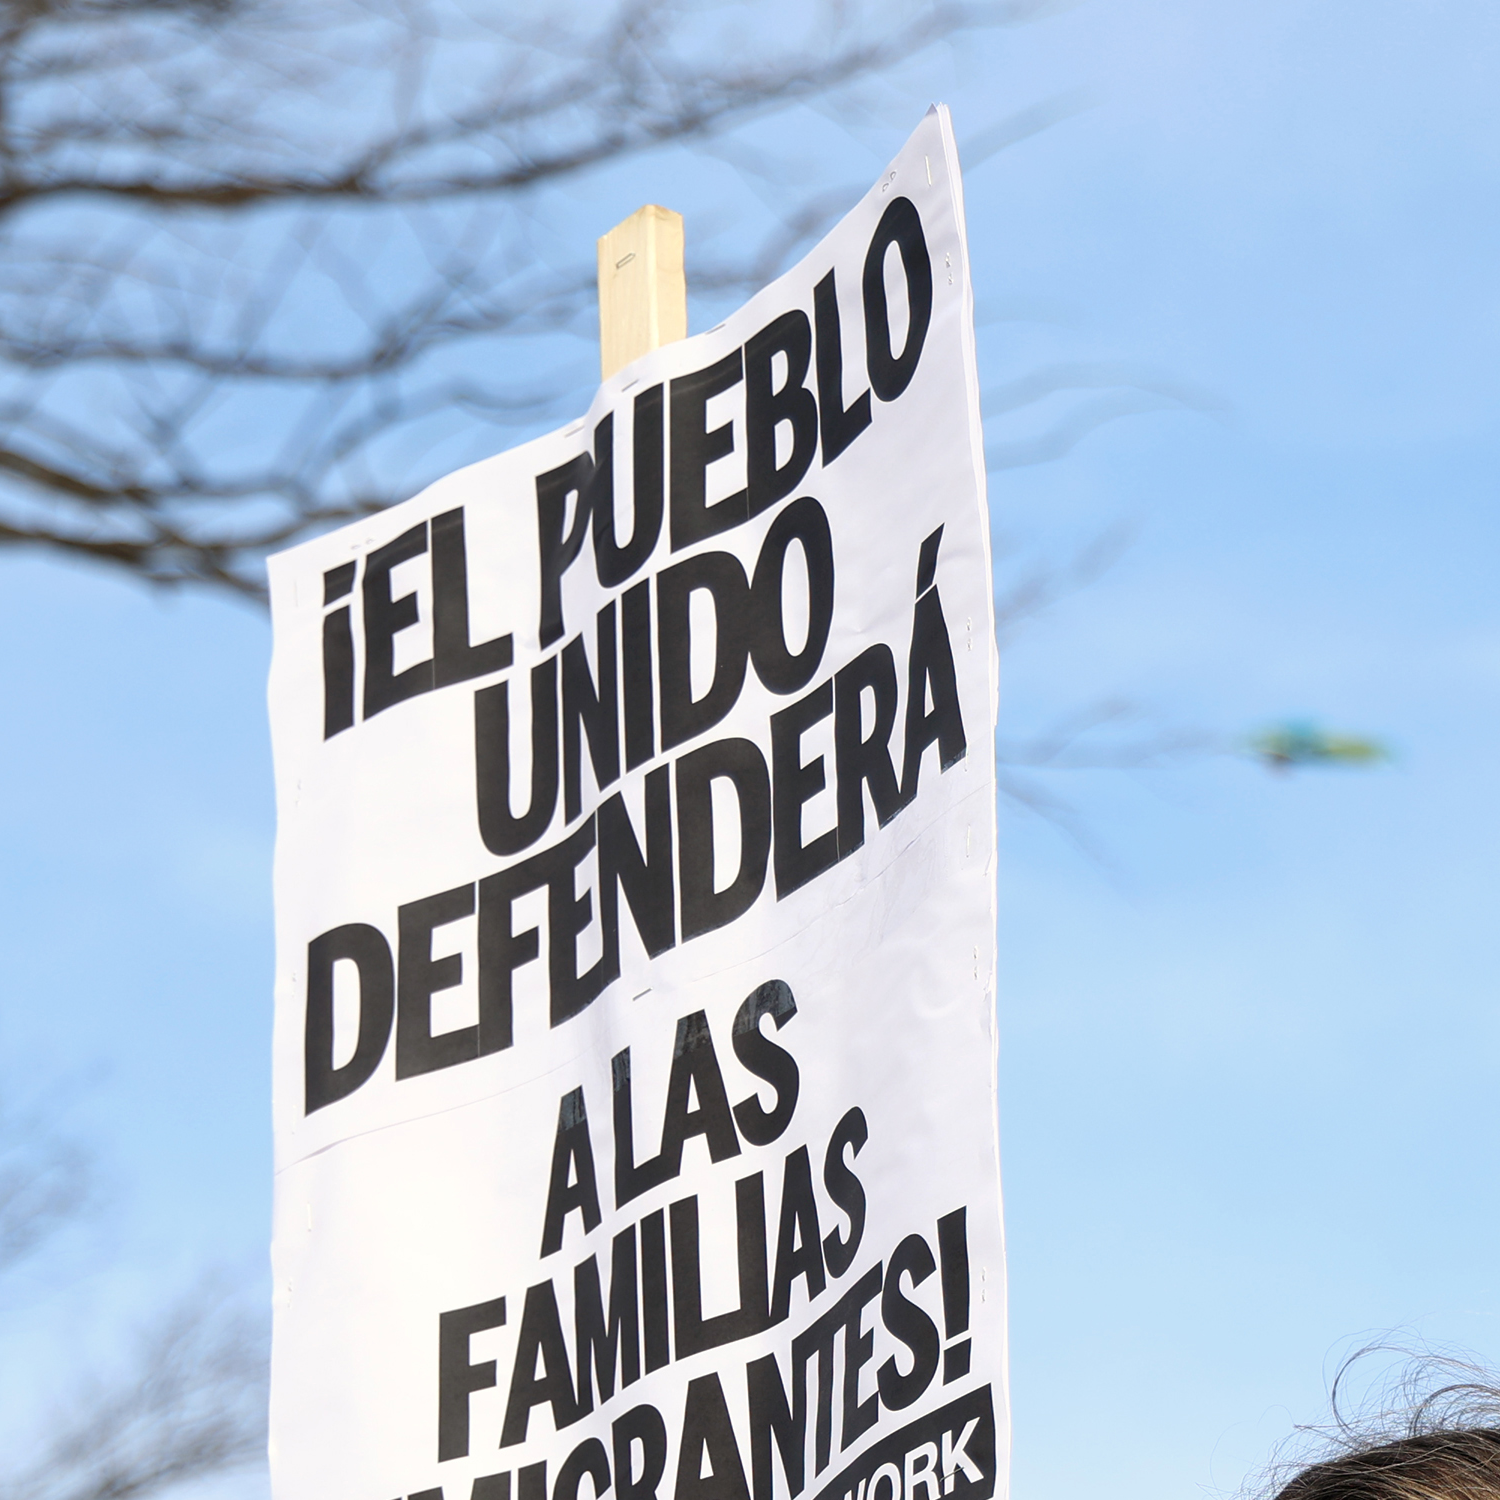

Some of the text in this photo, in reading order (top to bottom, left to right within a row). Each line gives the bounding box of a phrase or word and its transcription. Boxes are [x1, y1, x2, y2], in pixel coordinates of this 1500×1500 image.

[323, 196, 933, 741] ¡EL PUEBLO
[304, 522, 967, 1116] DEFENDERÁ
[474, 496, 835, 856] UNIDO
[438, 1106, 869, 1463] FAMILIAS
[540, 979, 800, 1259] A LAS
